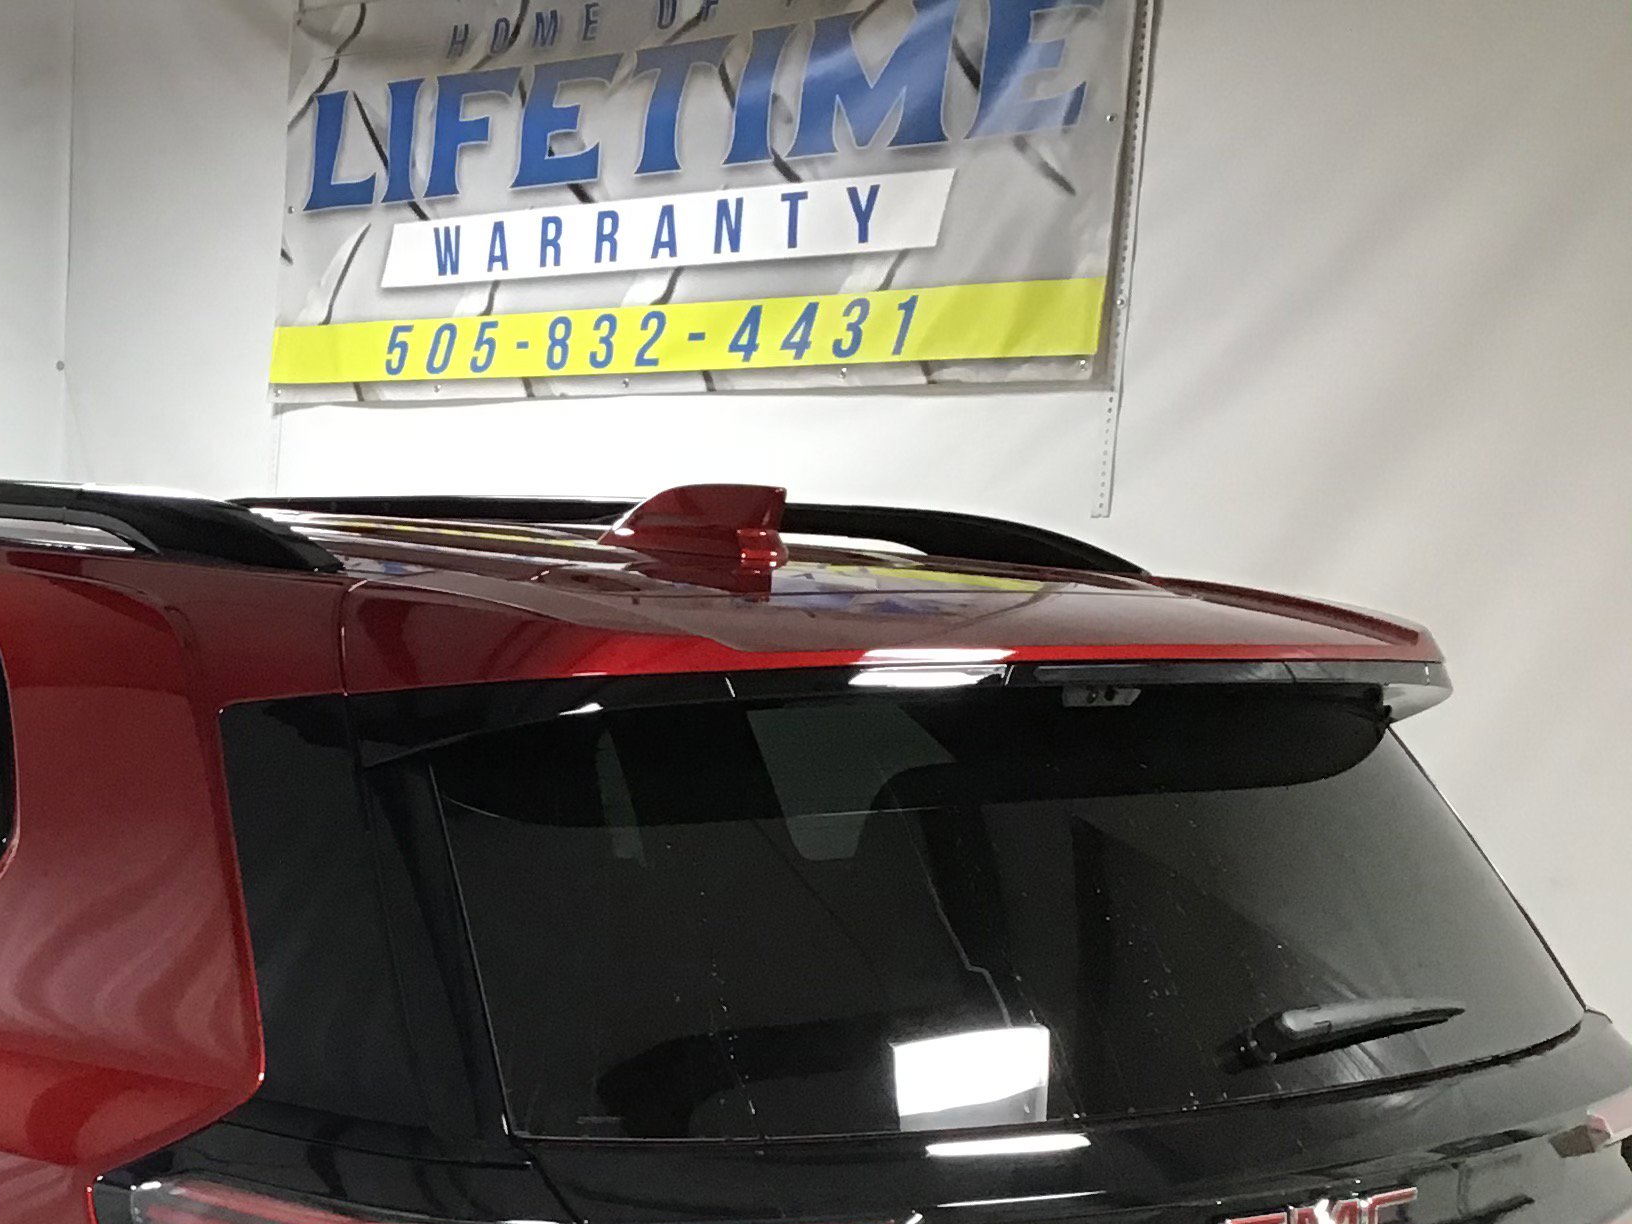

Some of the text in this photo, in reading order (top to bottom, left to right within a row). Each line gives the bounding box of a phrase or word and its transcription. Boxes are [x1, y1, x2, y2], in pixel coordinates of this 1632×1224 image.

[446, 2, 600, 59] HOME
[303, 0, 1105, 212] LIFETIME
[433, 184, 880, 277] WARRANTY
[384, 295, 920, 376] 505-832-4431
